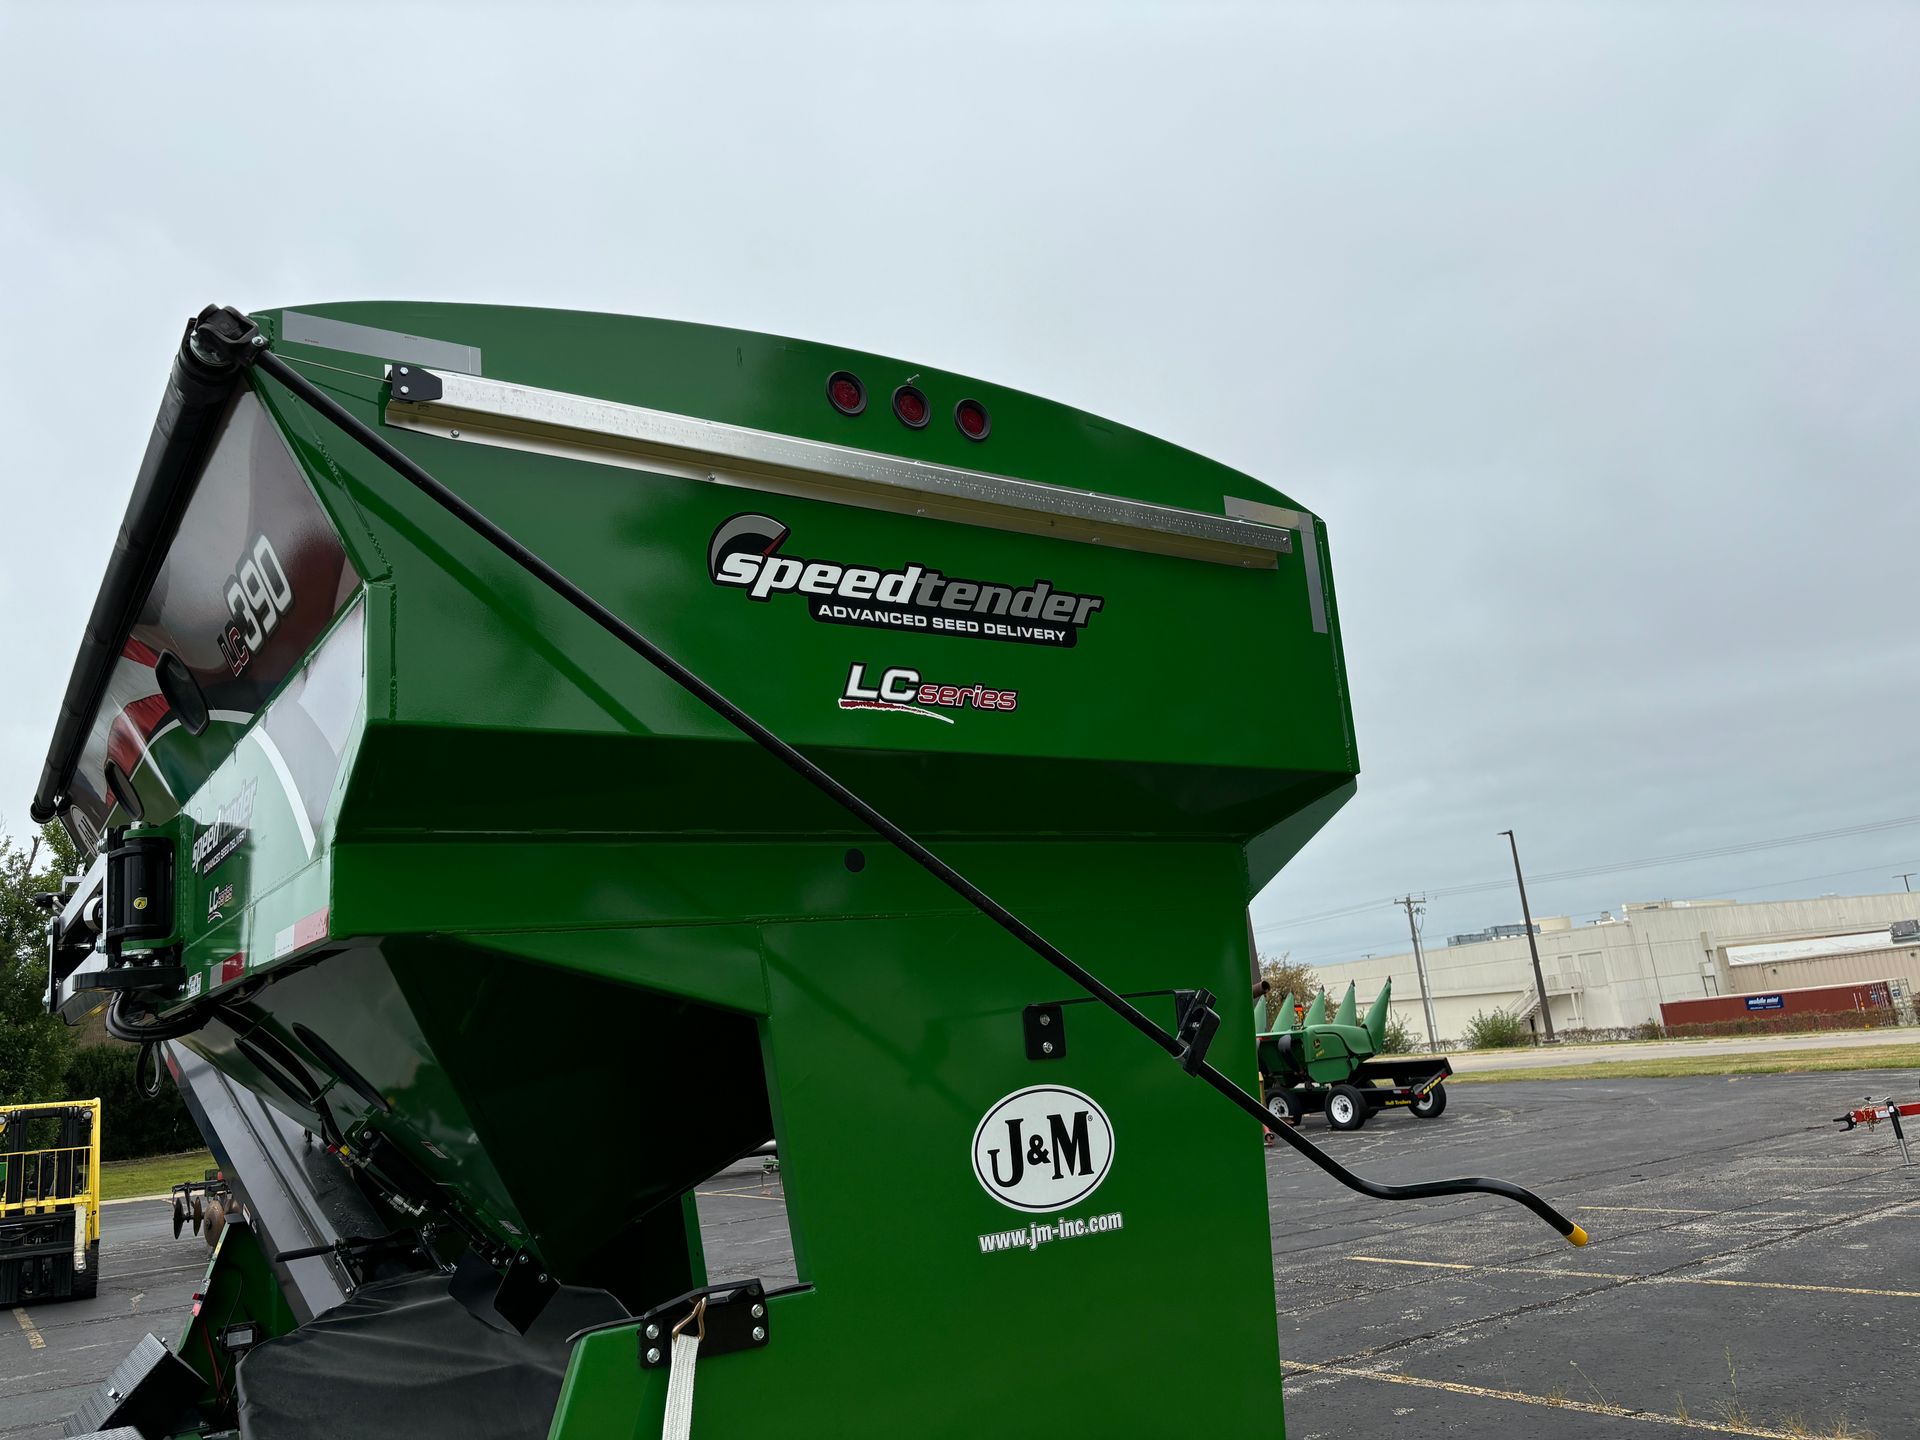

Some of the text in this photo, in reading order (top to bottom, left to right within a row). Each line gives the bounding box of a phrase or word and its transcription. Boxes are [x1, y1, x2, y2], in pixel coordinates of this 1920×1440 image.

[818, 604, 1066, 642] ADVANCED SEED DELIVERY
[979, 1212, 1123, 1252] www.jm-inc.com
